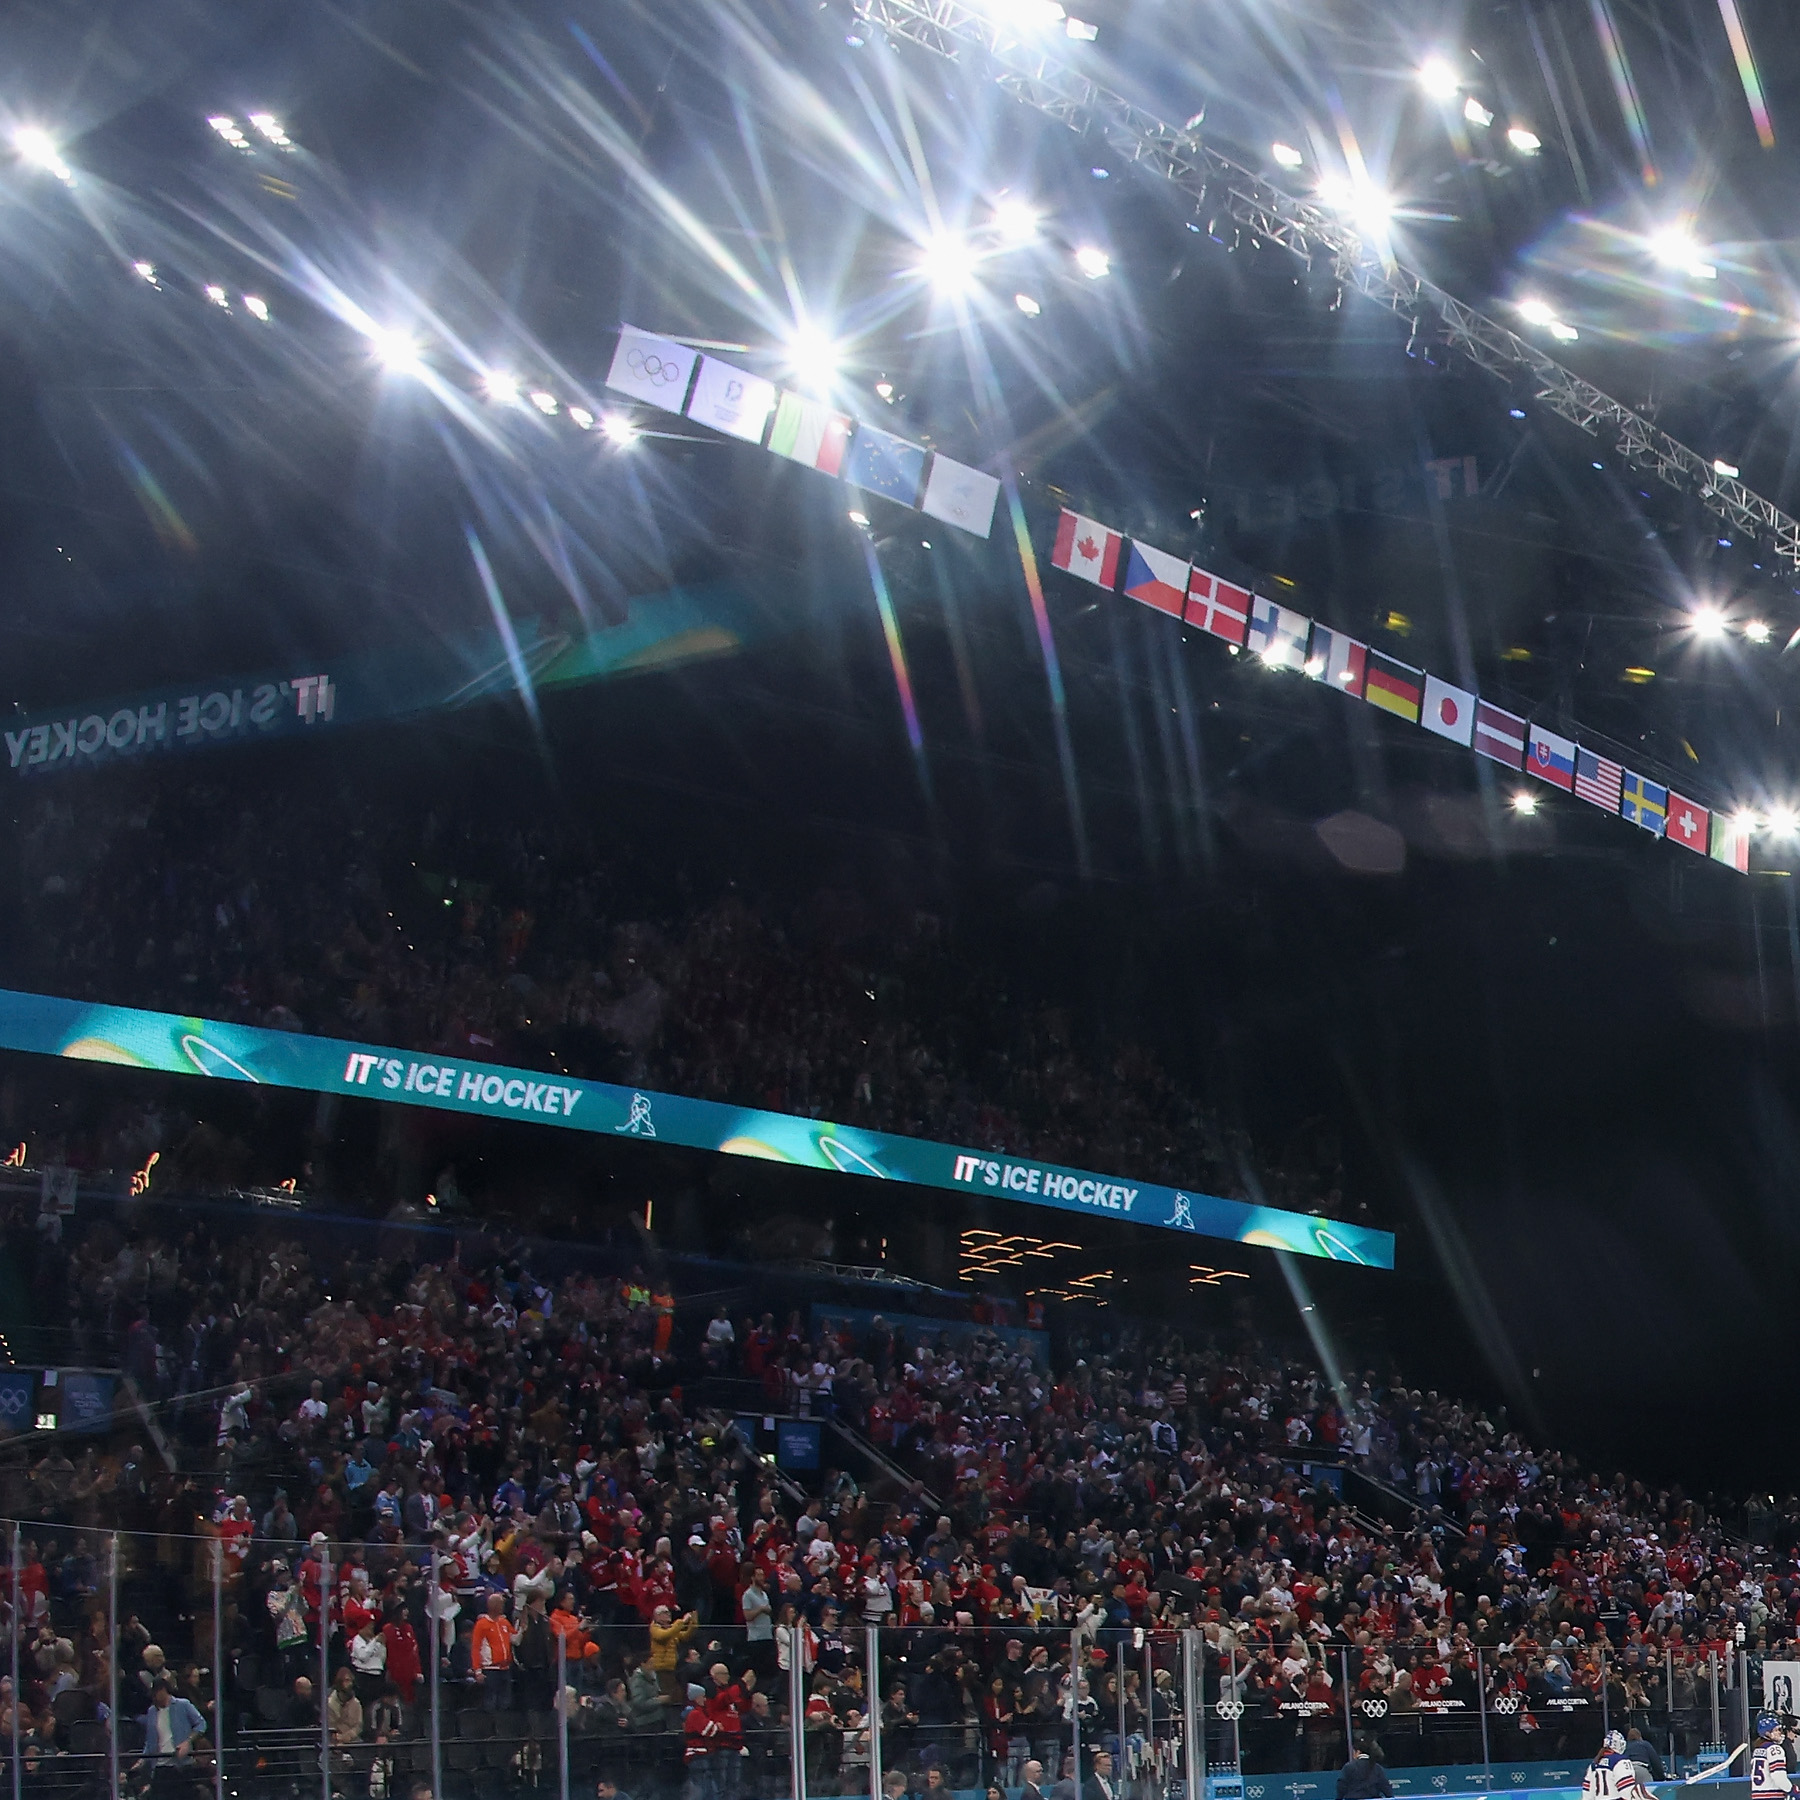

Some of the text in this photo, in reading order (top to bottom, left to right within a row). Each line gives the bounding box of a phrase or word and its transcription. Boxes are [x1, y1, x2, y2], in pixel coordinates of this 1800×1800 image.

[344, 1052, 583, 1116] IT'S ICE HOCKEY
[953, 1154, 1139, 1212] IT'S ICE HOCKEY
[1770, 1745, 1782, 1757] 25
